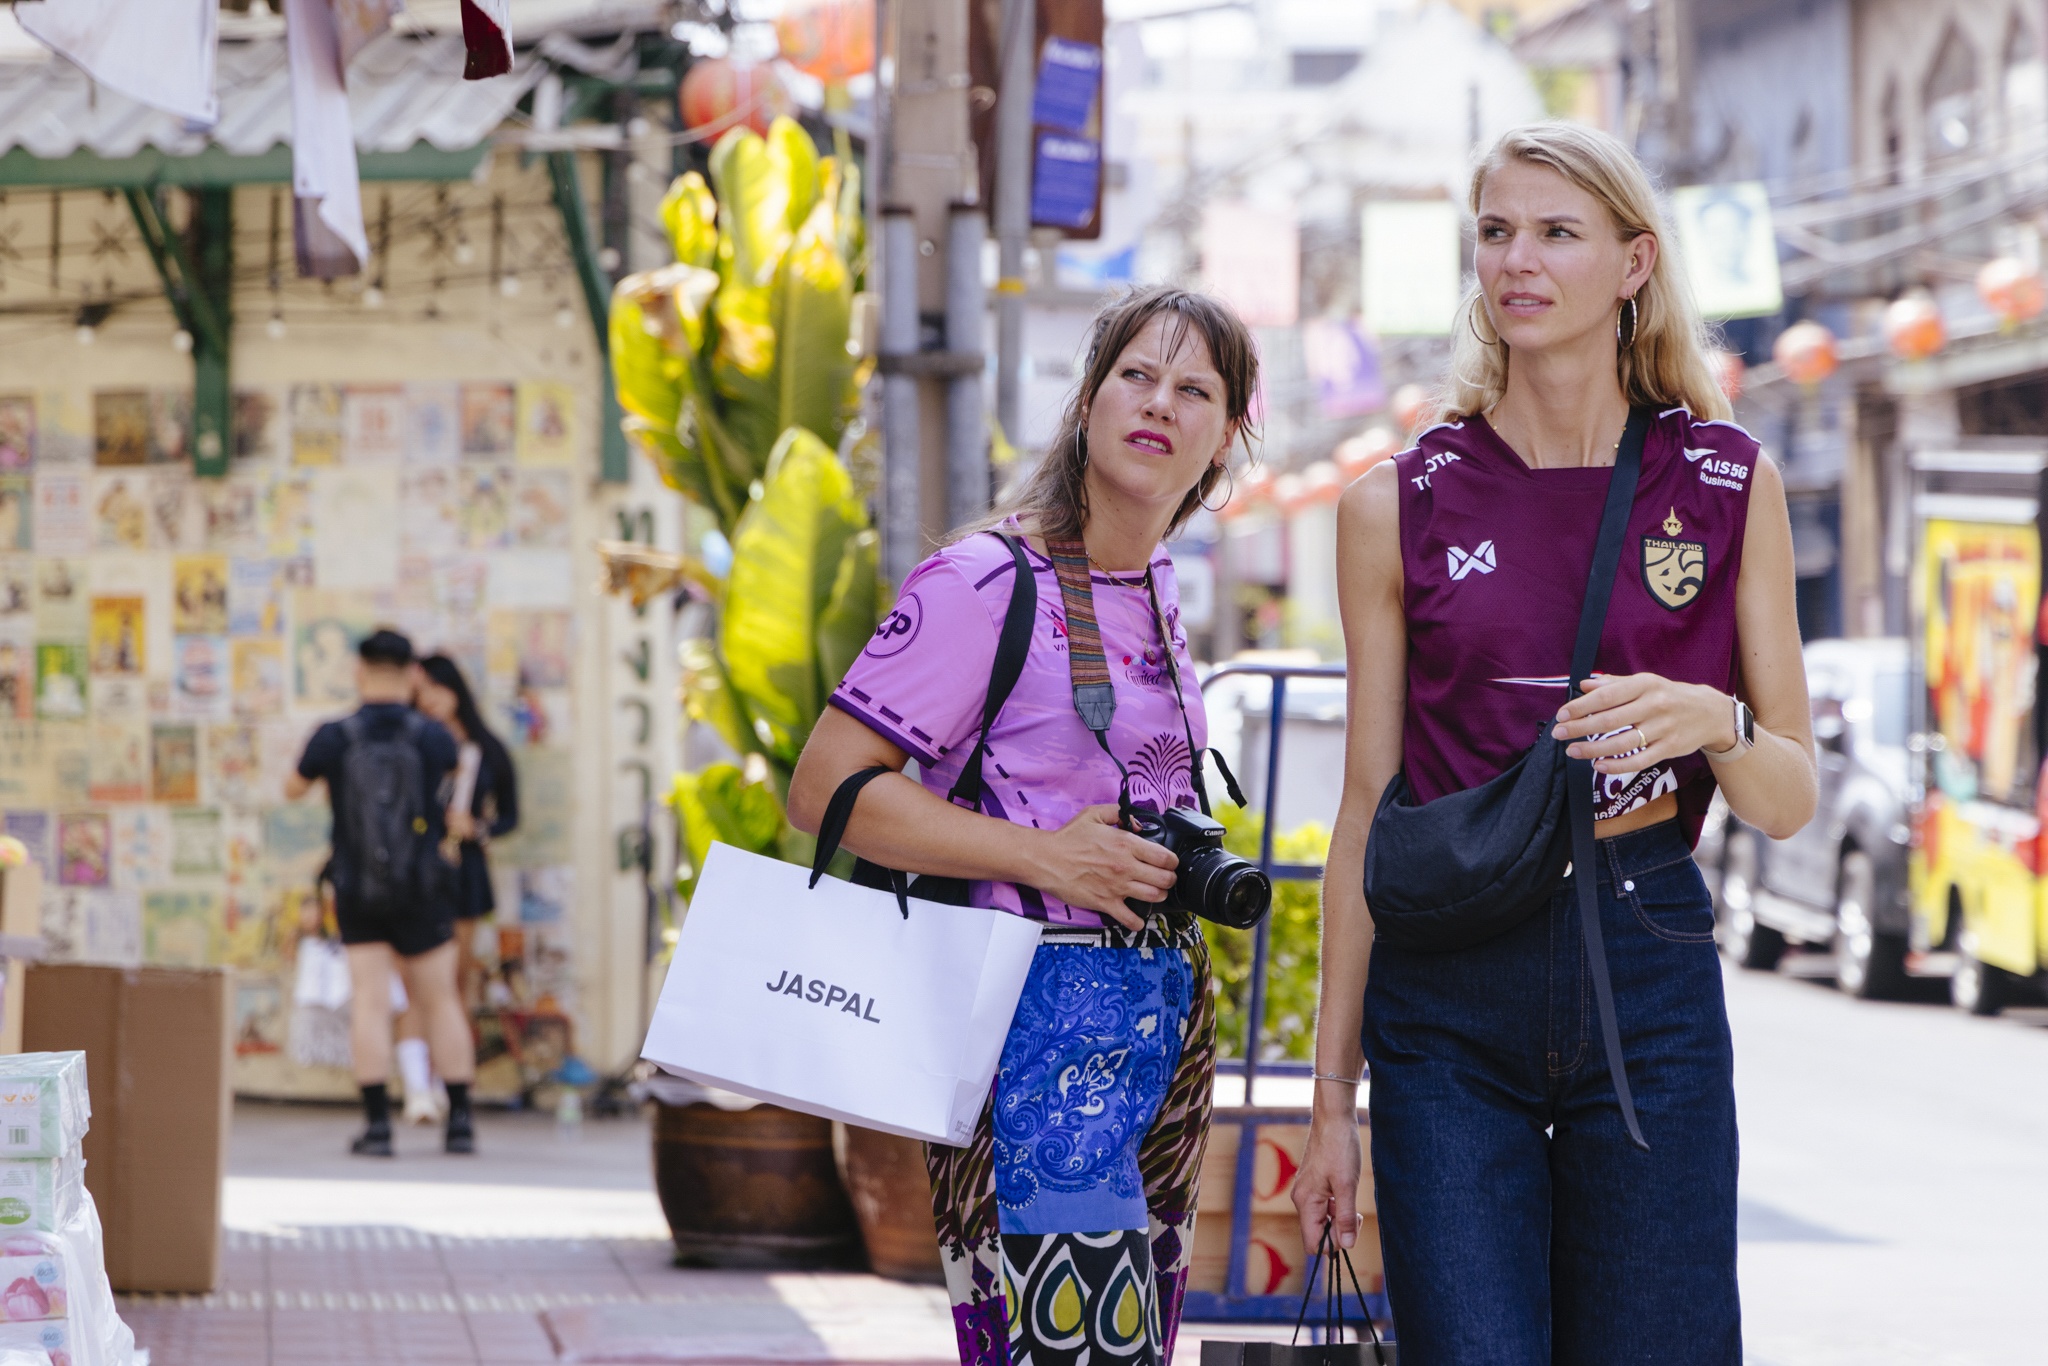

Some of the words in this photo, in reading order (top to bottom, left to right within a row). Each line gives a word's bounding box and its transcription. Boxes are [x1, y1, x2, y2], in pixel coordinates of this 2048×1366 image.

[1411, 451, 1461, 491] TOTA
[1700, 471, 1743, 491] Business
[1645, 539, 1703, 551] THAILAND
[1204, 829, 1225, 837] Canon
[766, 970, 881, 1024] JASPAL
